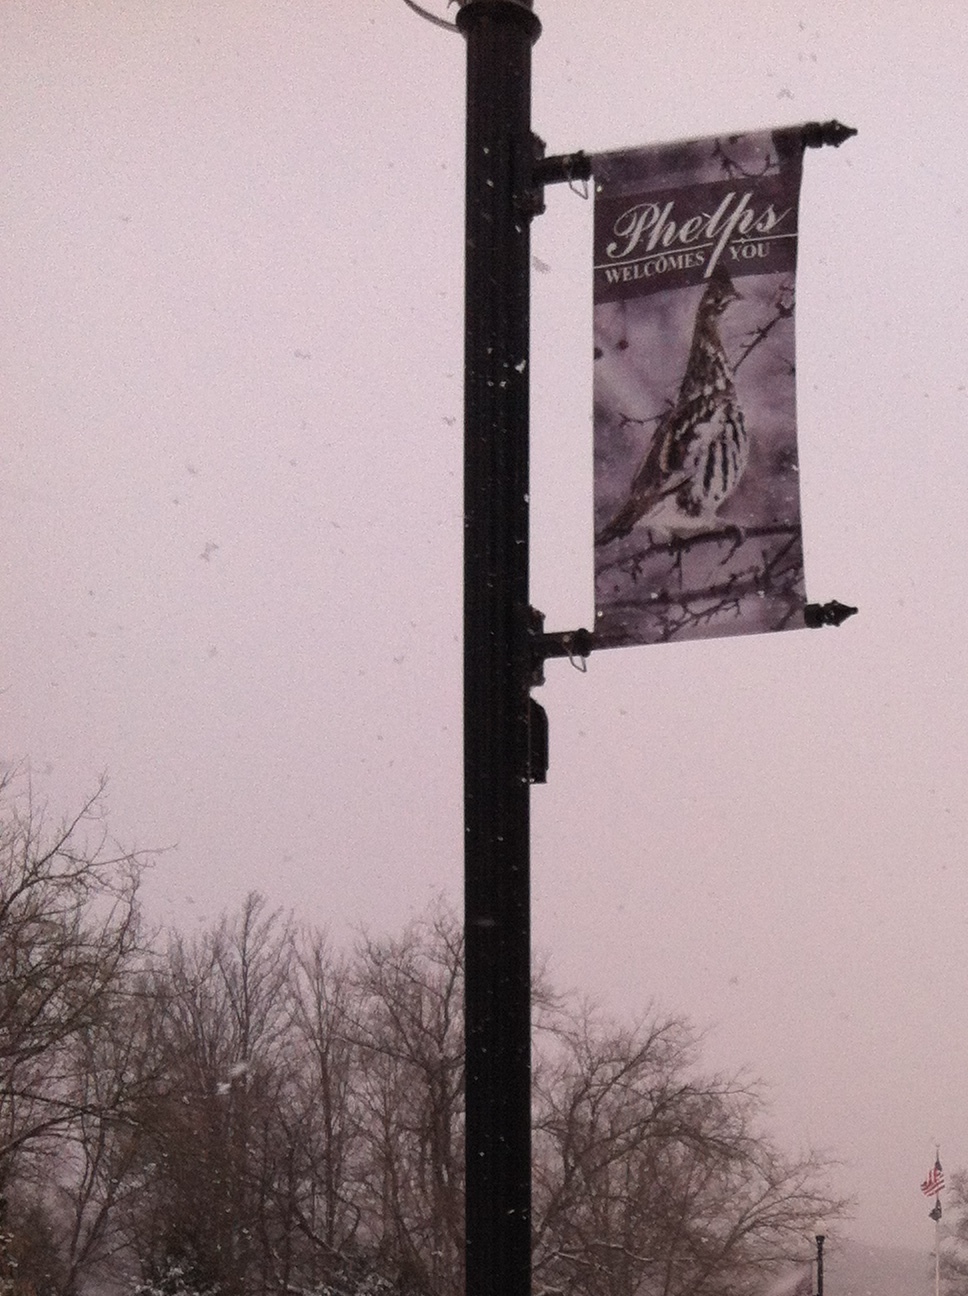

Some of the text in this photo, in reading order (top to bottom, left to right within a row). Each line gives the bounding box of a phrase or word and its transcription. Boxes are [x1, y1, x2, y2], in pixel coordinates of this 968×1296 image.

[604, 242, 771, 285] WELCOMES YOU
[606, 191, 793, 279] Phelps
